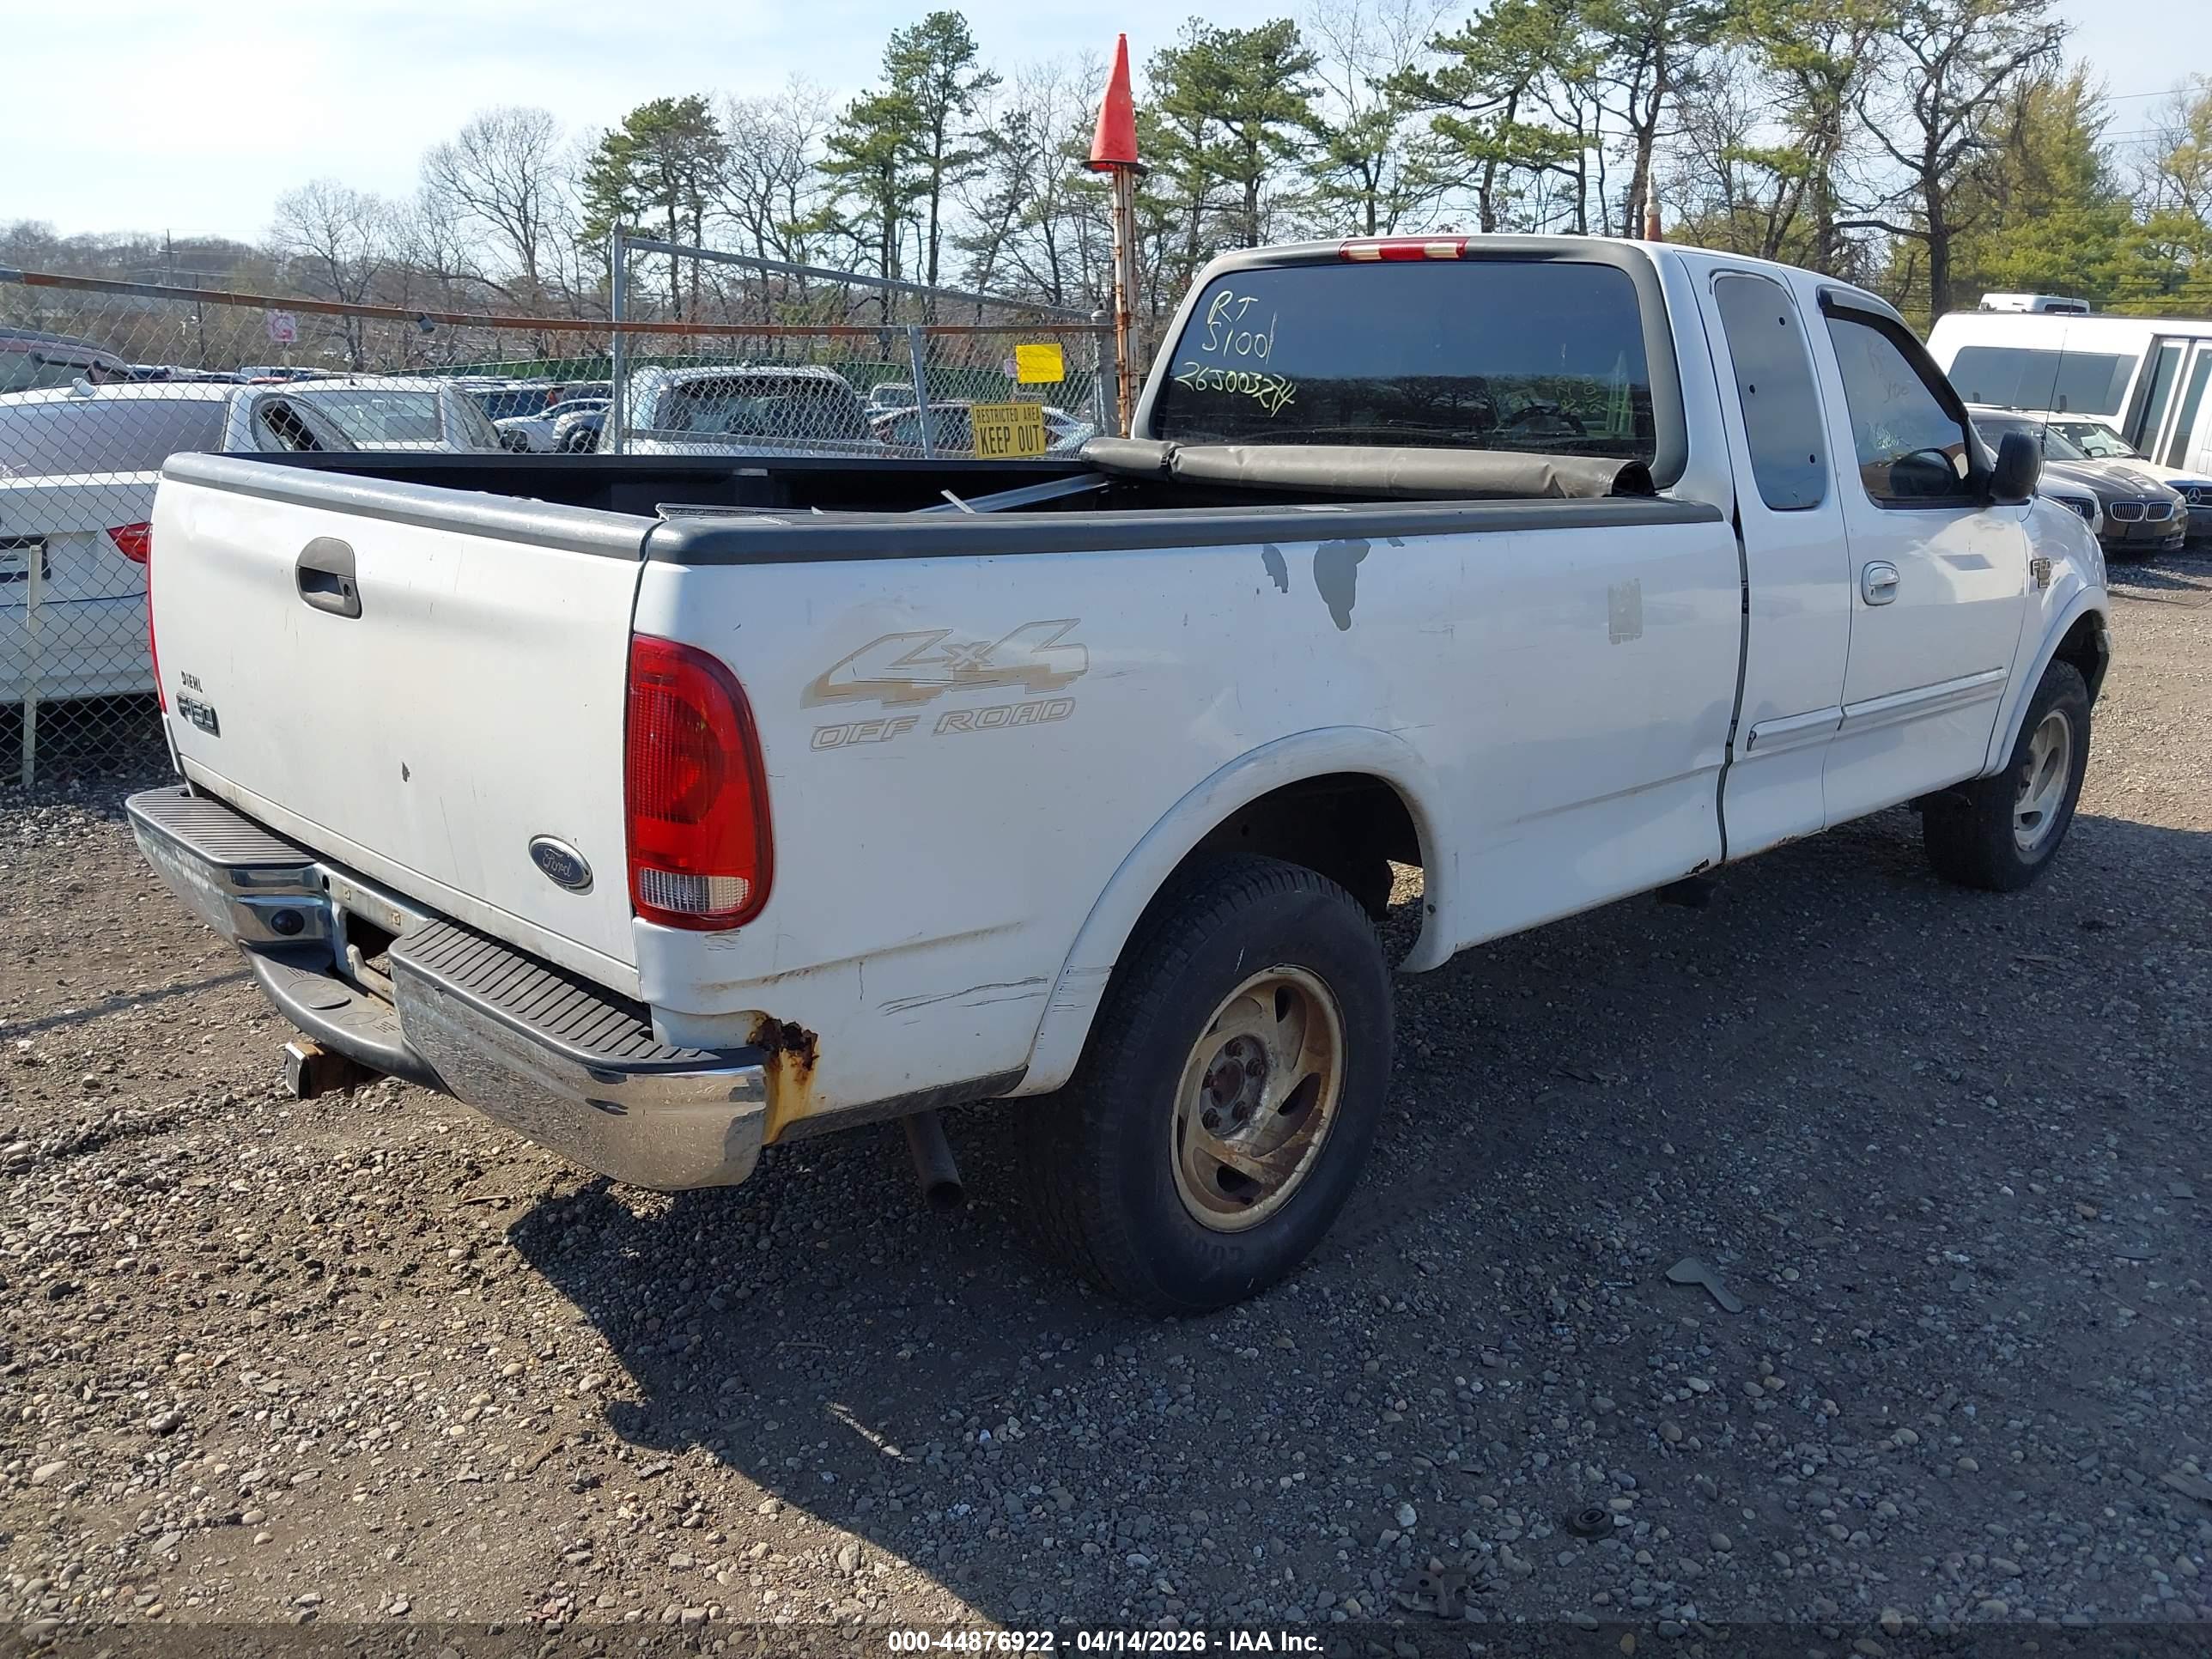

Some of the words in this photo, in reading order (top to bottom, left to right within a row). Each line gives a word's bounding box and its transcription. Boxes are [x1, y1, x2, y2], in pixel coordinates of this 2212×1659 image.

[976, 408, 1019, 424] RESTRICTED
[1024, 406, 1040, 422] AREA
[980, 426, 1011, 455] KEEP
[1018, 424, 1040, 453] OUT
[810, 714, 921, 752] OFF
[932, 697, 1077, 737] ROAD
